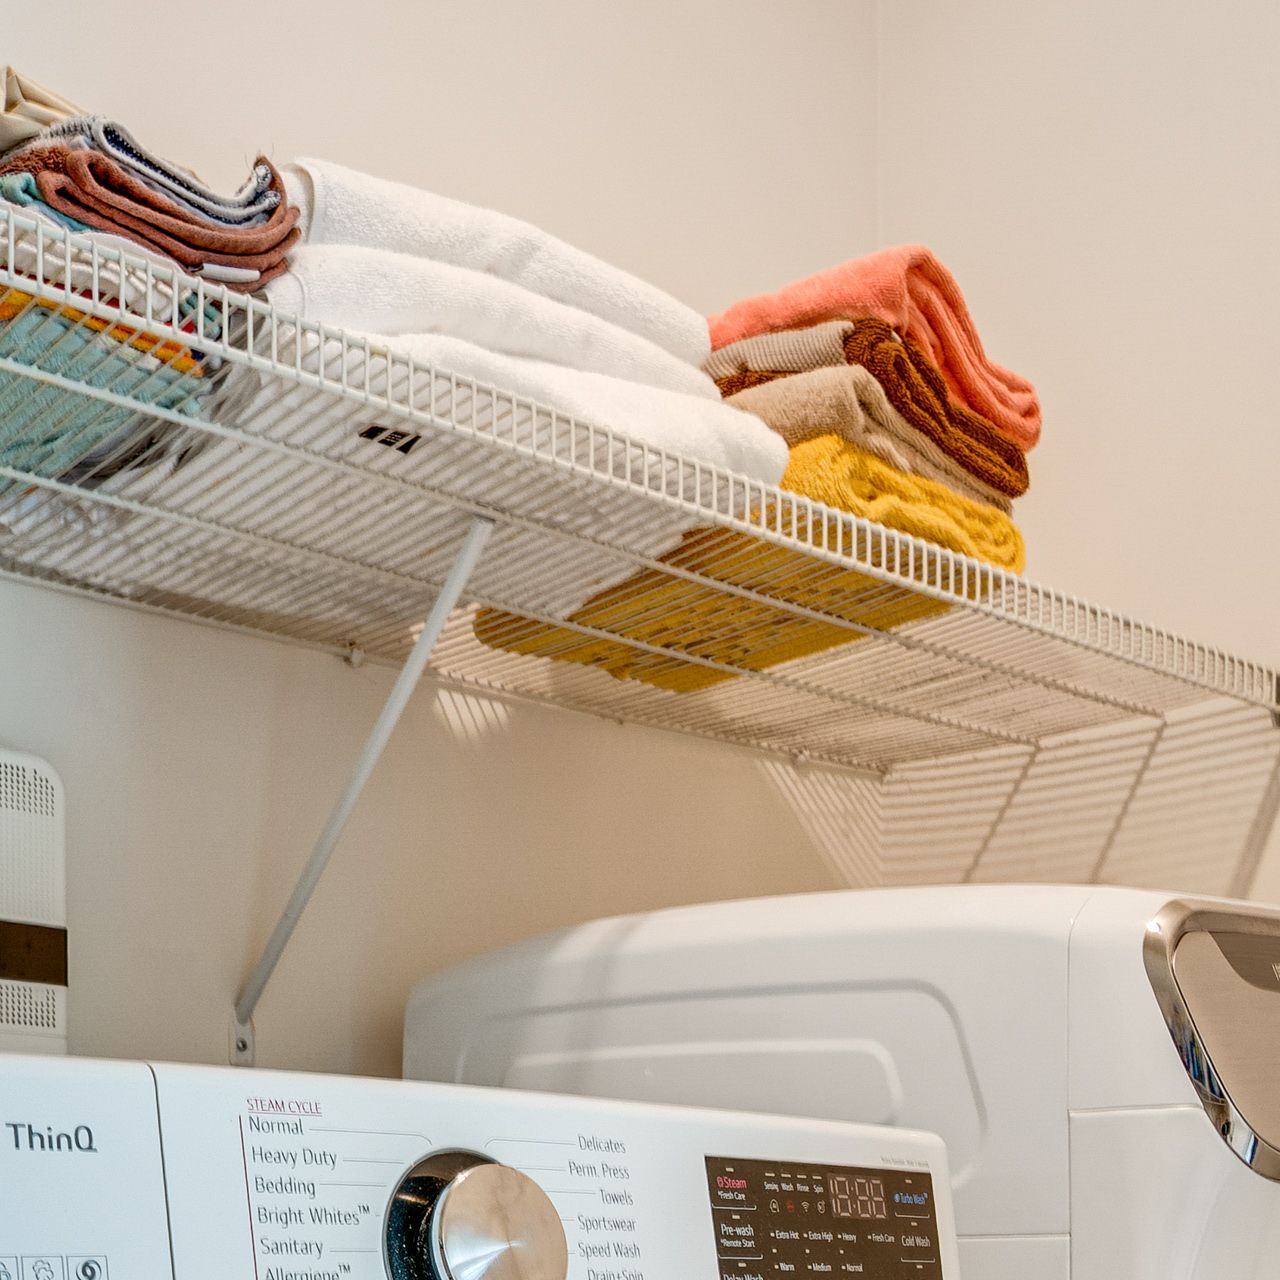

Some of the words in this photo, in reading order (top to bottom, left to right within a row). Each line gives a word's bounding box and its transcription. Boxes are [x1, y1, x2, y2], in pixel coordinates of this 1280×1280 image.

[247, 1099, 286, 1112] STEAM
[288, 1101, 323, 1114] CYCLE
[248, 1116, 304, 1135] Normal
[5, 1123, 97, 1152] ThinQ
[578, 1135, 626, 1154] Delicates
[252, 1146, 298, 1170] Heavy
[302, 1148, 337, 1170] Duty
[568, 1160, 599, 1178] Perm.
[602, 1162, 630, 1180] Press
[255, 1176, 316, 1200] Bedding
[724, 1177, 747, 1189] Steam
[781, 1182, 794, 1192] Wash
[796, 1184, 810, 1192] Rinse
[814, 1185, 824, 1194] Spin
[600, 1188, 634, 1206] Towels
[734, 1192, 746, 1200] Care
[258, 1206, 305, 1229] Bright
[578, 1214, 636, 1234] Sportswear
[720, 1224, 754, 1236] Pre-wash
[776, 1230, 790, 1239] Extra
[790, 1231, 800, 1240] Hot
[809, 1232, 821, 1240] Extra
[821, 1232, 833, 1242] High
[842, 1232, 856, 1243] Heavy
[872, 1234, 884, 1242] Fresh
[884, 1234, 895, 1243] Care
[742, 1240, 755, 1248] Start
[902, 1236, 914, 1247] Cold
[915, 1237, 930, 1247] Wash
[260, 1237, 323, 1260] Sanitary
[578, 1242, 611, 1261] Speed
[612, 1242, 641, 1258] Wash
[780, 1263, 795, 1271] Warm
[846, 1264, 863, 1272] Normal
